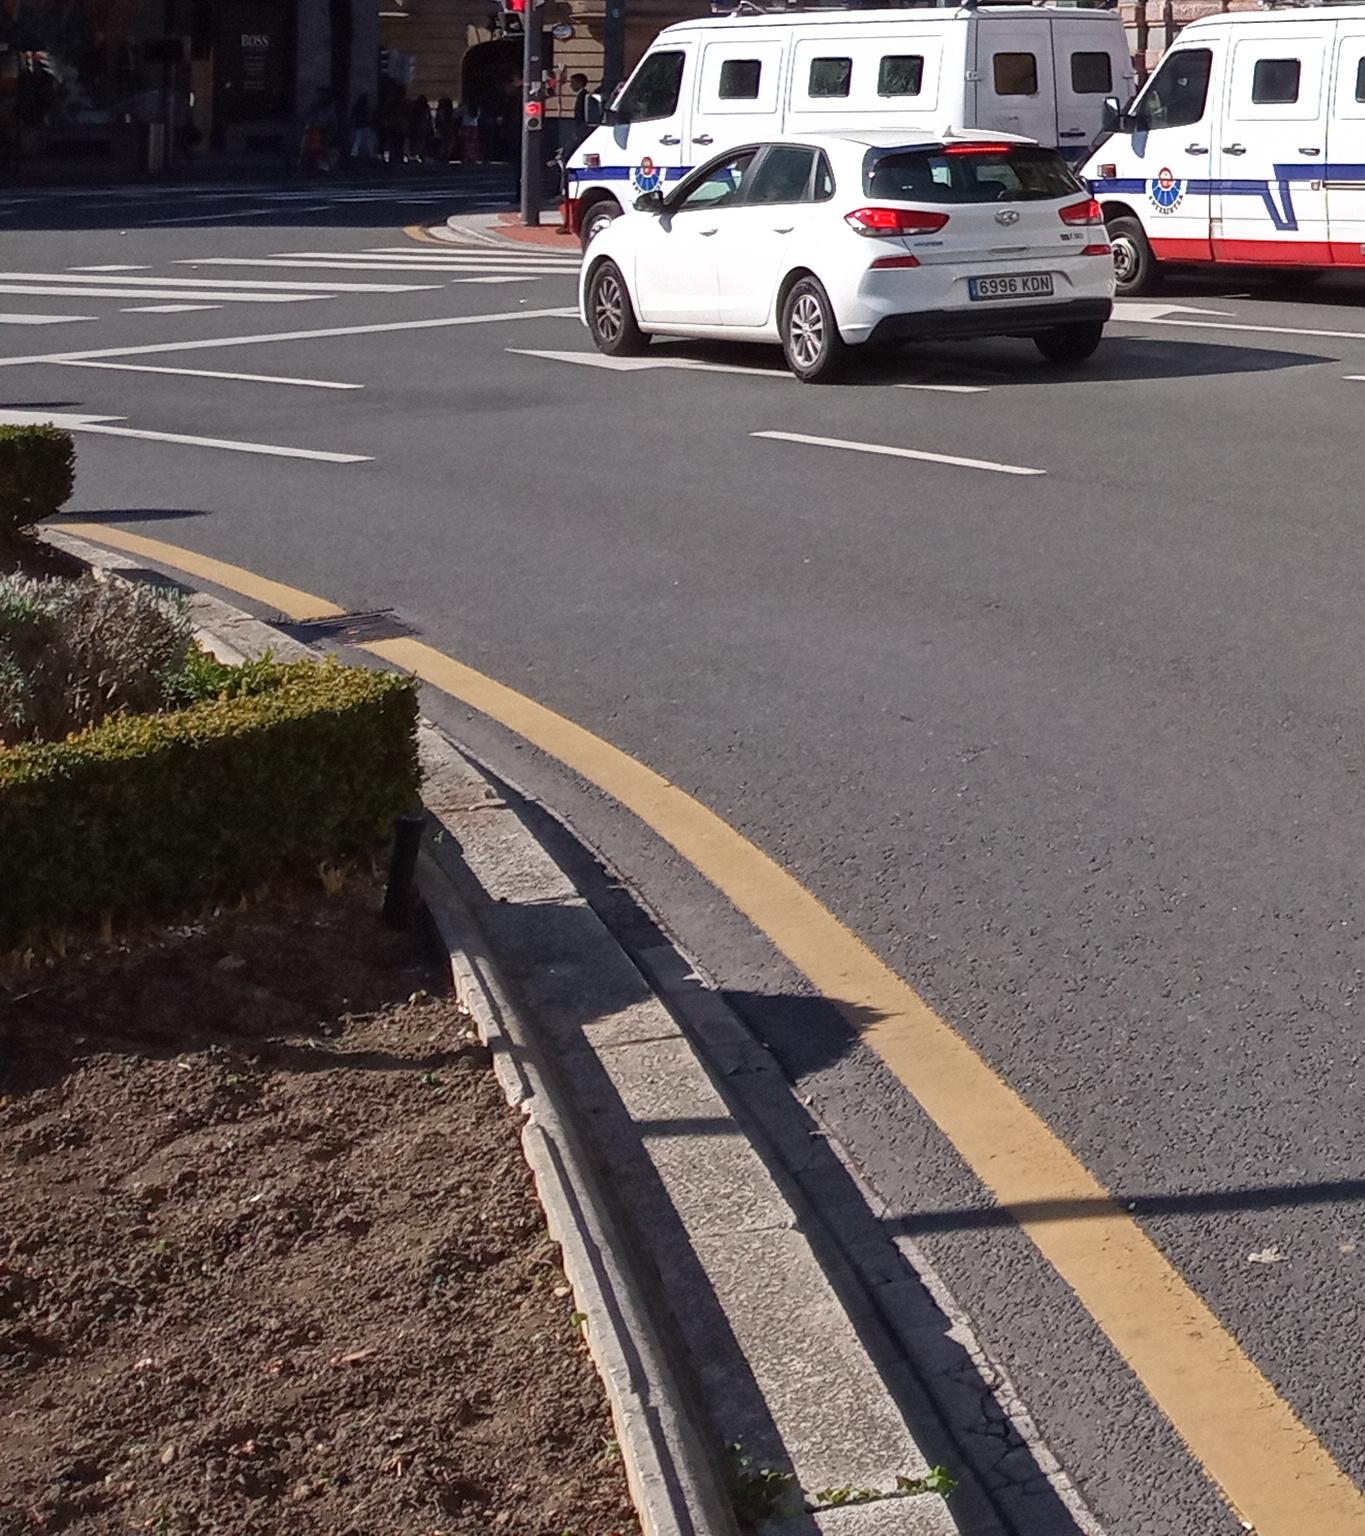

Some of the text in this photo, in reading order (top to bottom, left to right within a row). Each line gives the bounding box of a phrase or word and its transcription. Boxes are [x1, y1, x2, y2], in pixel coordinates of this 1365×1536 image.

[240, 33, 270, 48] BOSS
[979, 276, 1049, 295] 6996 KDN
